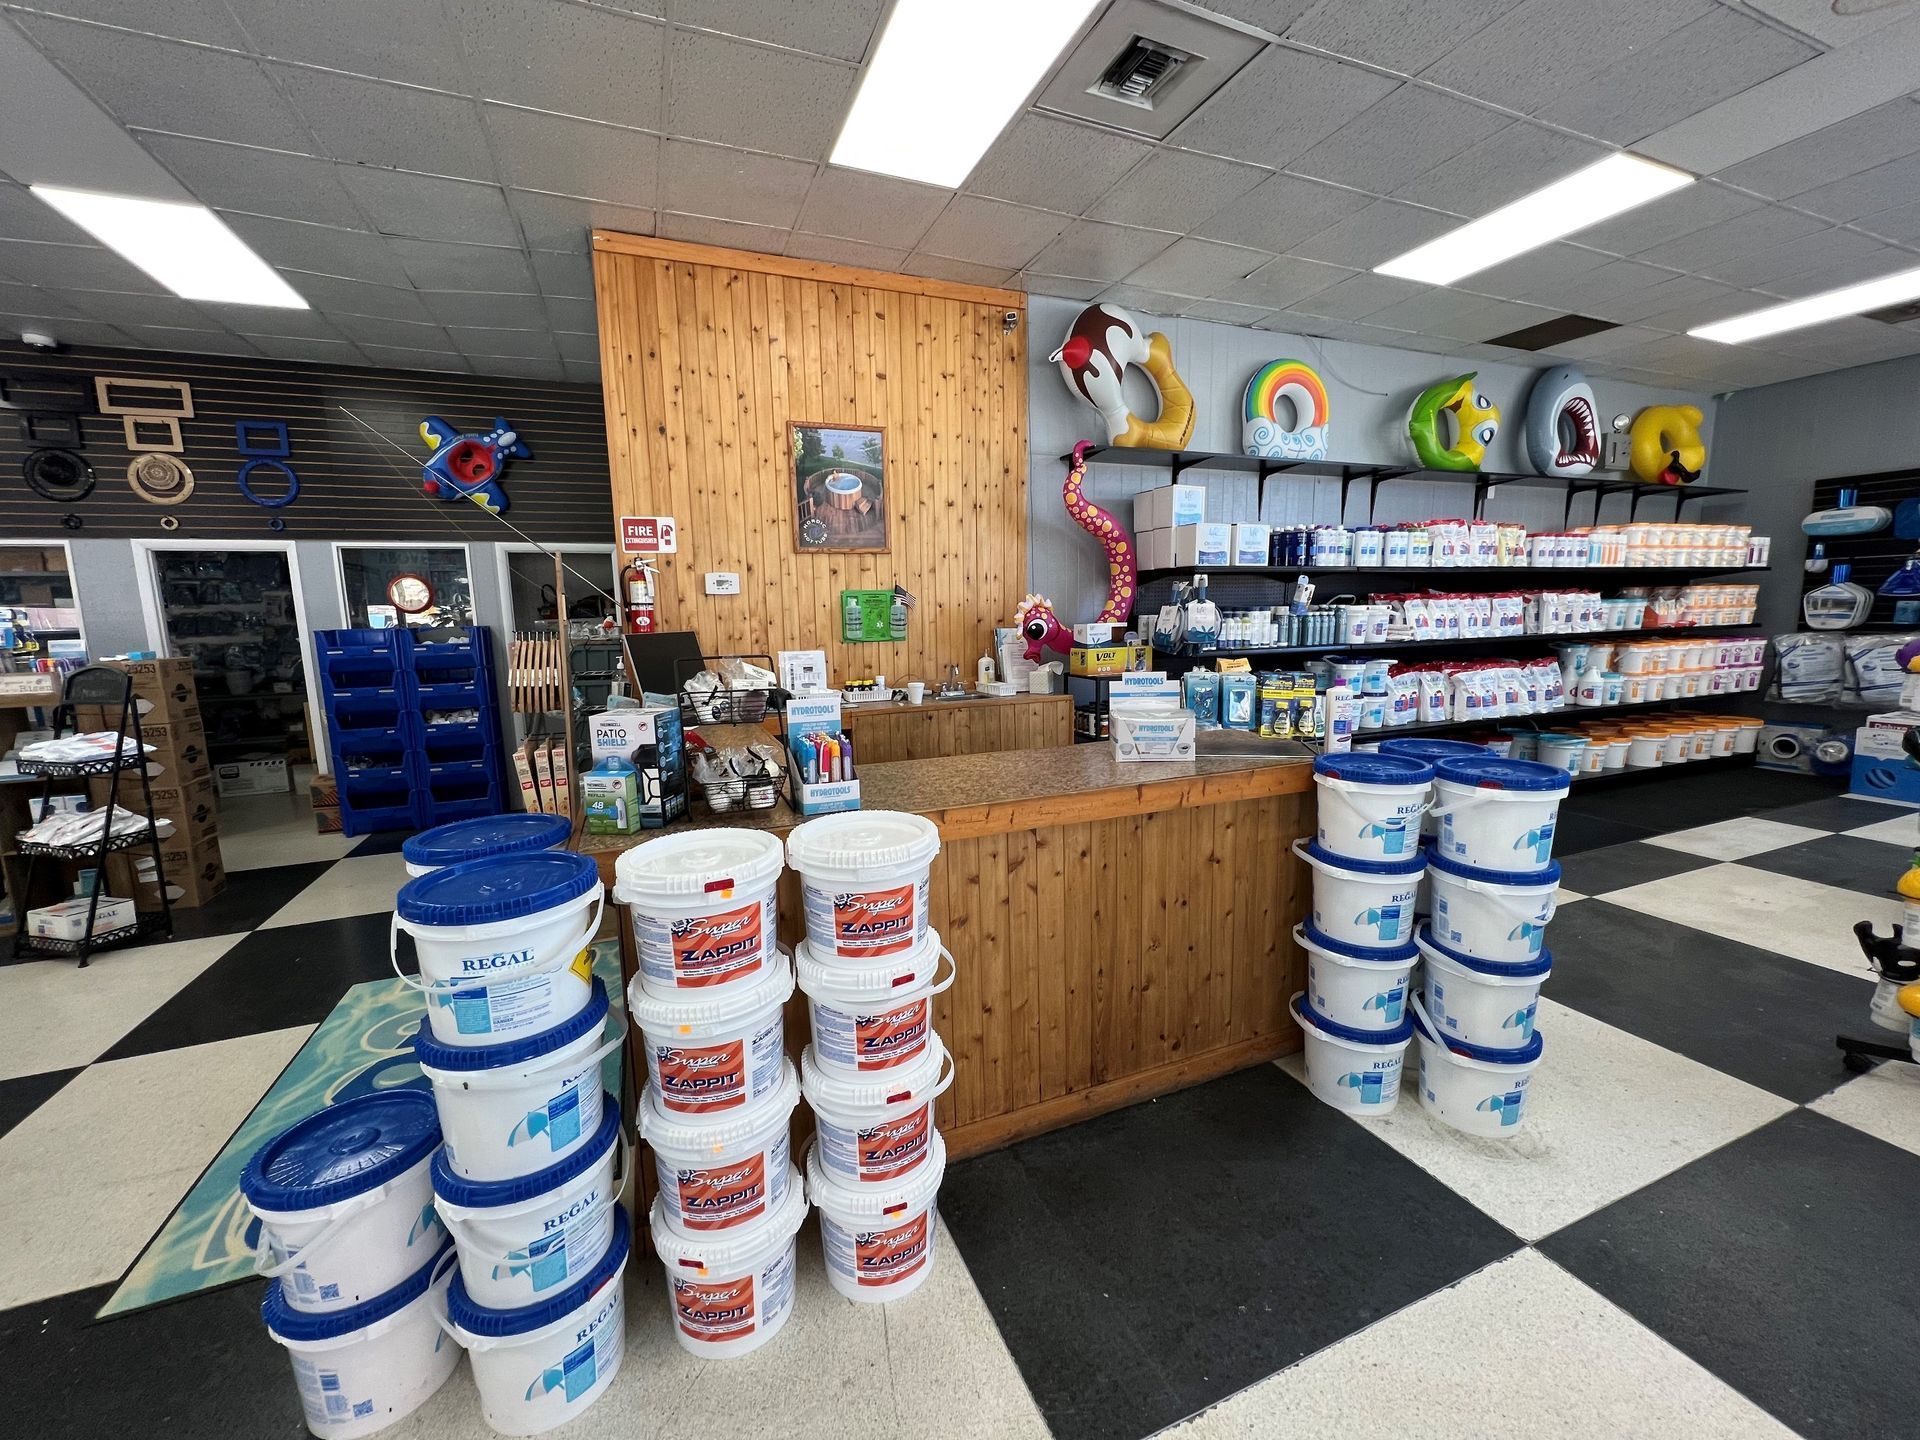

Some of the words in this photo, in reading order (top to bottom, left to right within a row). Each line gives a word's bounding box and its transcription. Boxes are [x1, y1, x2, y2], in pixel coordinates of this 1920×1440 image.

[628, 526, 654, 536] FIRE
[803, 519, 827, 529] NORDIC
[1096, 652, 1116, 661] VOLT
[1125, 677, 1164, 685] HYDROTOOLS
[791, 705, 834, 716] HYDROTOOLS
[144, 727, 168, 737] 5253
[597, 729, 627, 739] PATIO
[597, 739, 627, 747] SHIELD
[152, 789, 178, 799] 5253
[810, 786, 850, 797] HYDROTOOLS
[163, 851, 188, 861] 5253
[847, 894, 905, 916] Super
[687, 916, 751, 940] Super
[841, 915, 910, 933] ZAPPIT
[681, 935, 757, 961] ZAPPIT
[462, 949, 534, 971] REGAL
[871, 1003, 921, 1027] Super
[863, 1022, 925, 1048] ZAPPIT
[668, 1050, 731, 1072] Super
[664, 1071, 740, 1089] ZAPPIT
[871, 1115, 923, 1141] Super
[865, 1131, 926, 1160] ZAPPIT
[689, 1167, 754, 1190] Super
[685, 1183, 760, 1208] ZAPPIT
[543, 1190, 598, 1232] REGAL
[868, 1225, 920, 1249] Super
[862, 1239, 926, 1266] ZAPPIT
[681, 1283, 741, 1303] Super
[576, 1294, 619, 1343] REGAL
[680, 1304, 749, 1321] ZAPPIT
